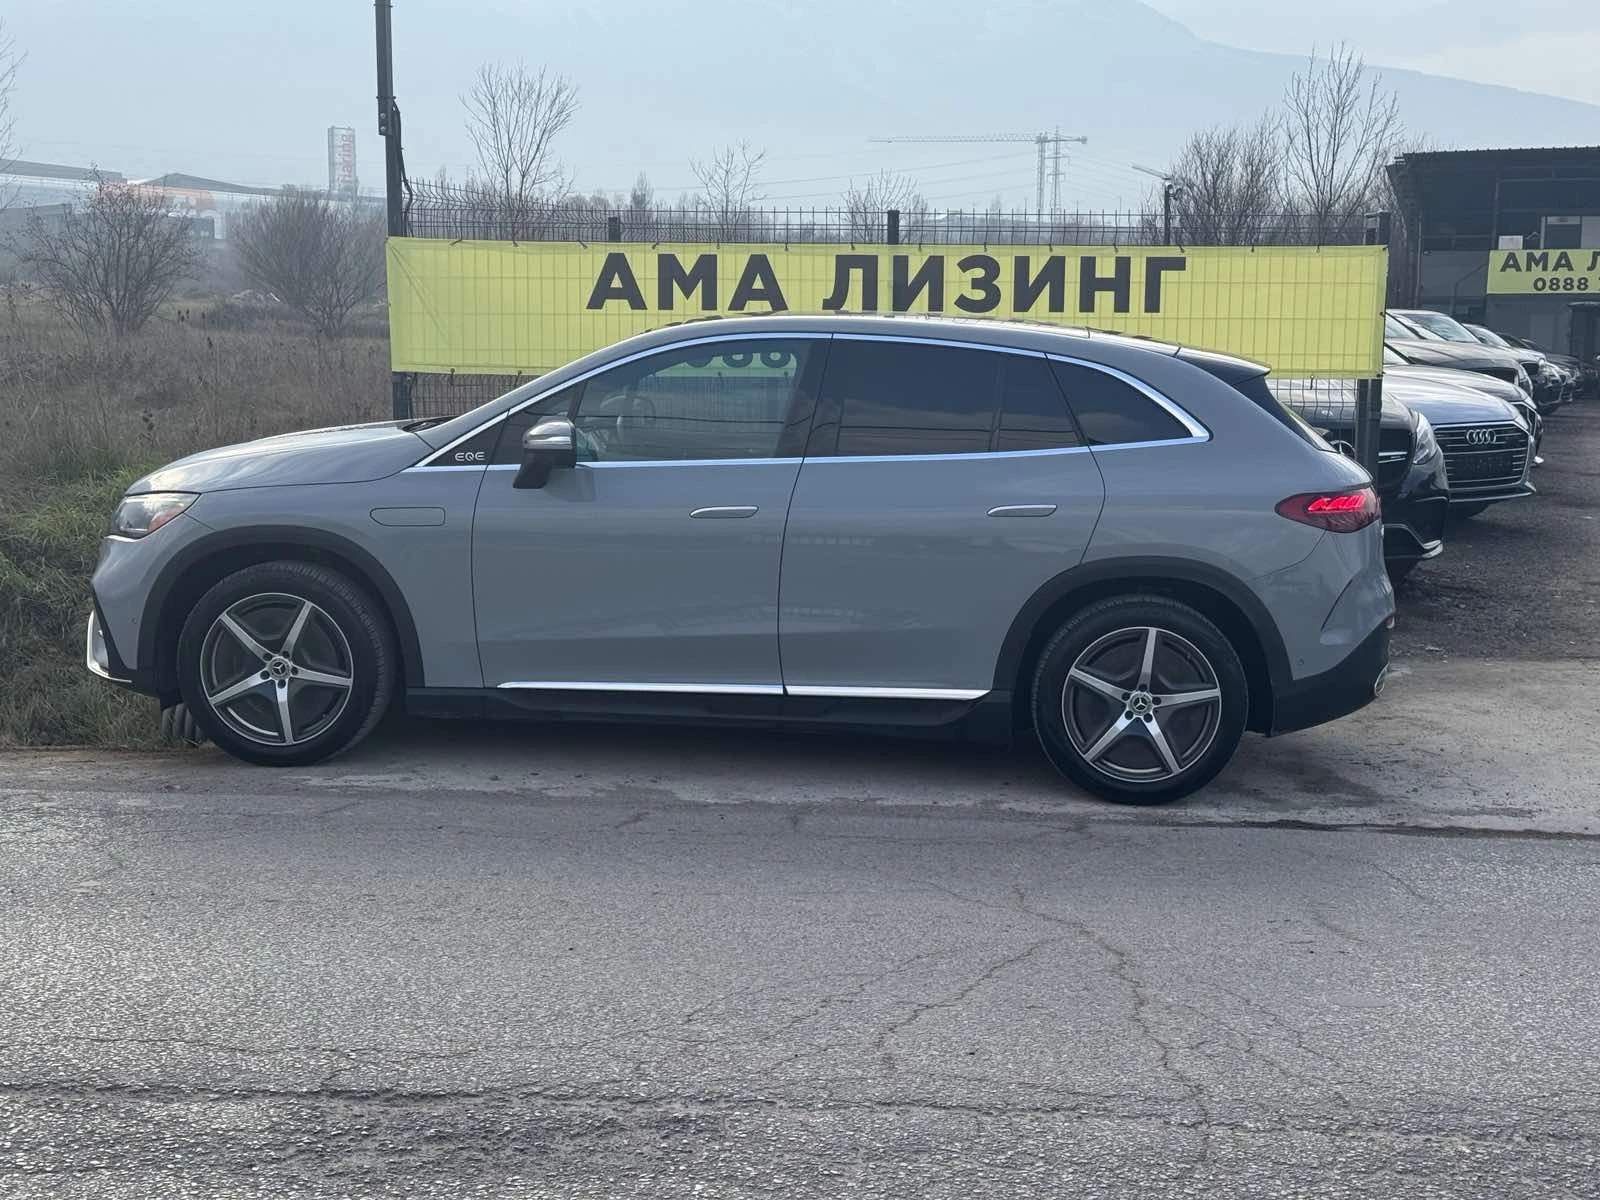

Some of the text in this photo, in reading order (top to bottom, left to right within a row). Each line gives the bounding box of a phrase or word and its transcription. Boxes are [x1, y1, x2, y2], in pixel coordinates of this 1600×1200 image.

[1500, 251, 1574, 272] АМА
[586, 252, 1187, 313] АМА ЛИЗИНГ
[1533, 277, 1589, 291] 0888
[455, 451, 486, 462] EQE
